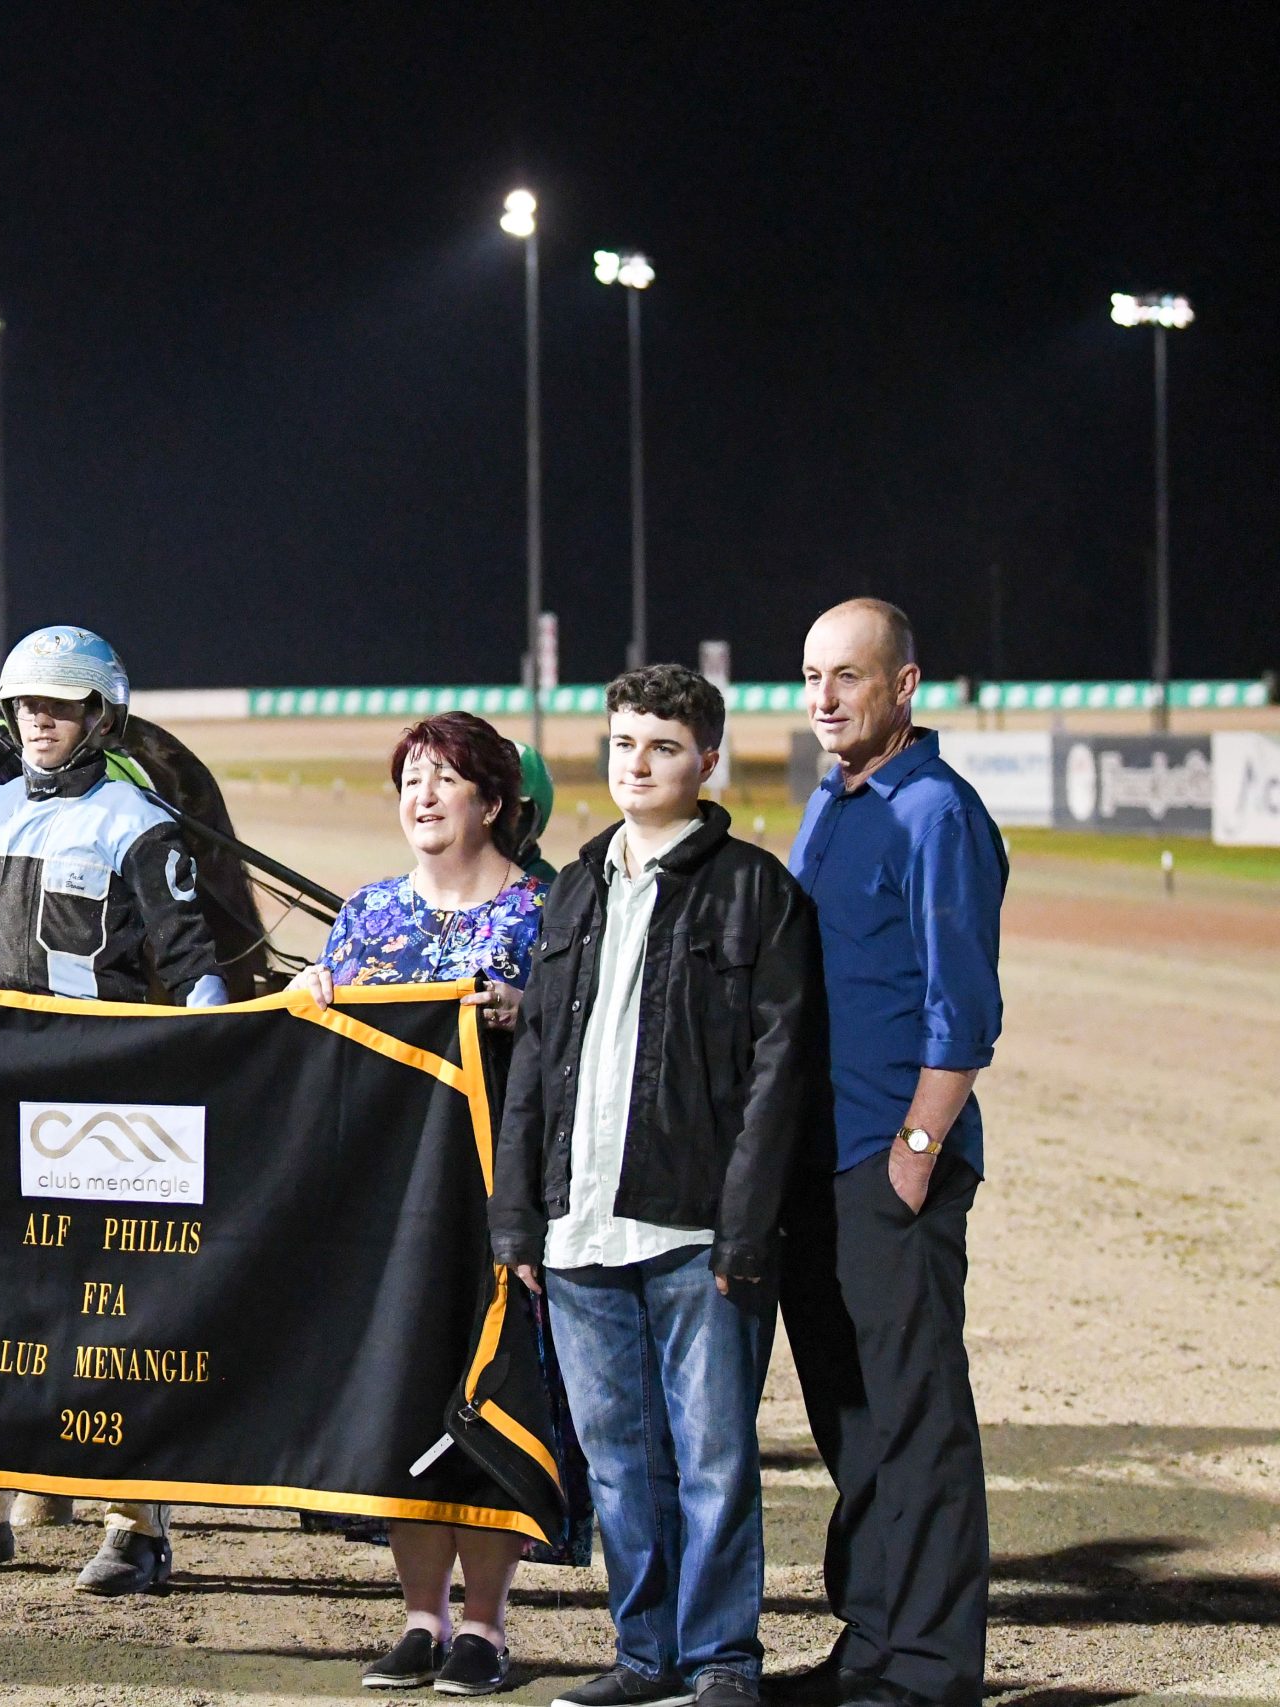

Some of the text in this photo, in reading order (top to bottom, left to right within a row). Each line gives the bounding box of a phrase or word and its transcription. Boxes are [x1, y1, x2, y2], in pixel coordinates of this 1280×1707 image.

[38, 1171, 191, 1198] club menangle
[22, 1212, 202, 1255] ALF PHILLIS
[80, 1282, 127, 1316] FFA
[72, 1345, 210, 1383] MENANGLE
[59, 1408, 124, 1446] 2023
